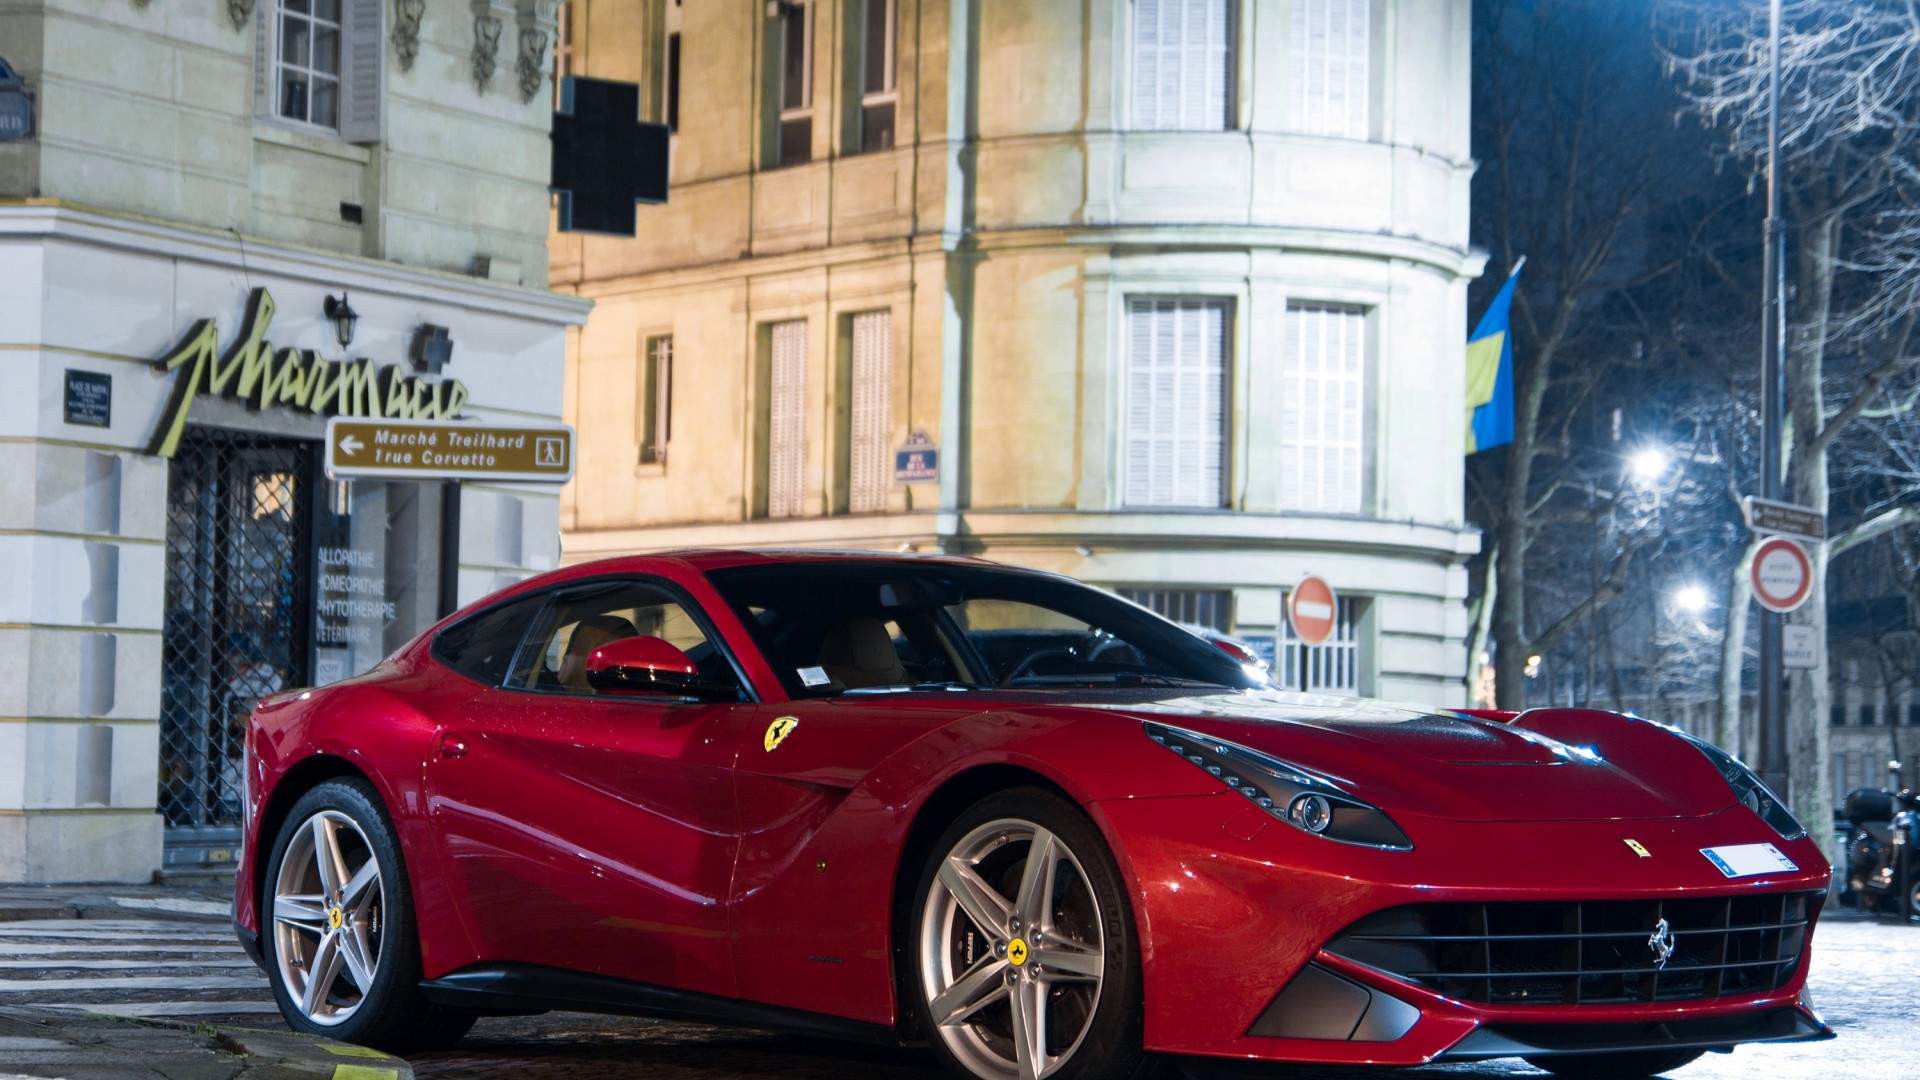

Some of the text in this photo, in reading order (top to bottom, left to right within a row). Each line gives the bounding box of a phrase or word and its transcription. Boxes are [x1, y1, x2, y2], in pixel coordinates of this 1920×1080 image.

[374, 430, 525, 449] Marché Treilhard
[422, 450, 496, 466] Corvetto
[318, 547, 375, 568] ALLOPATHIE
